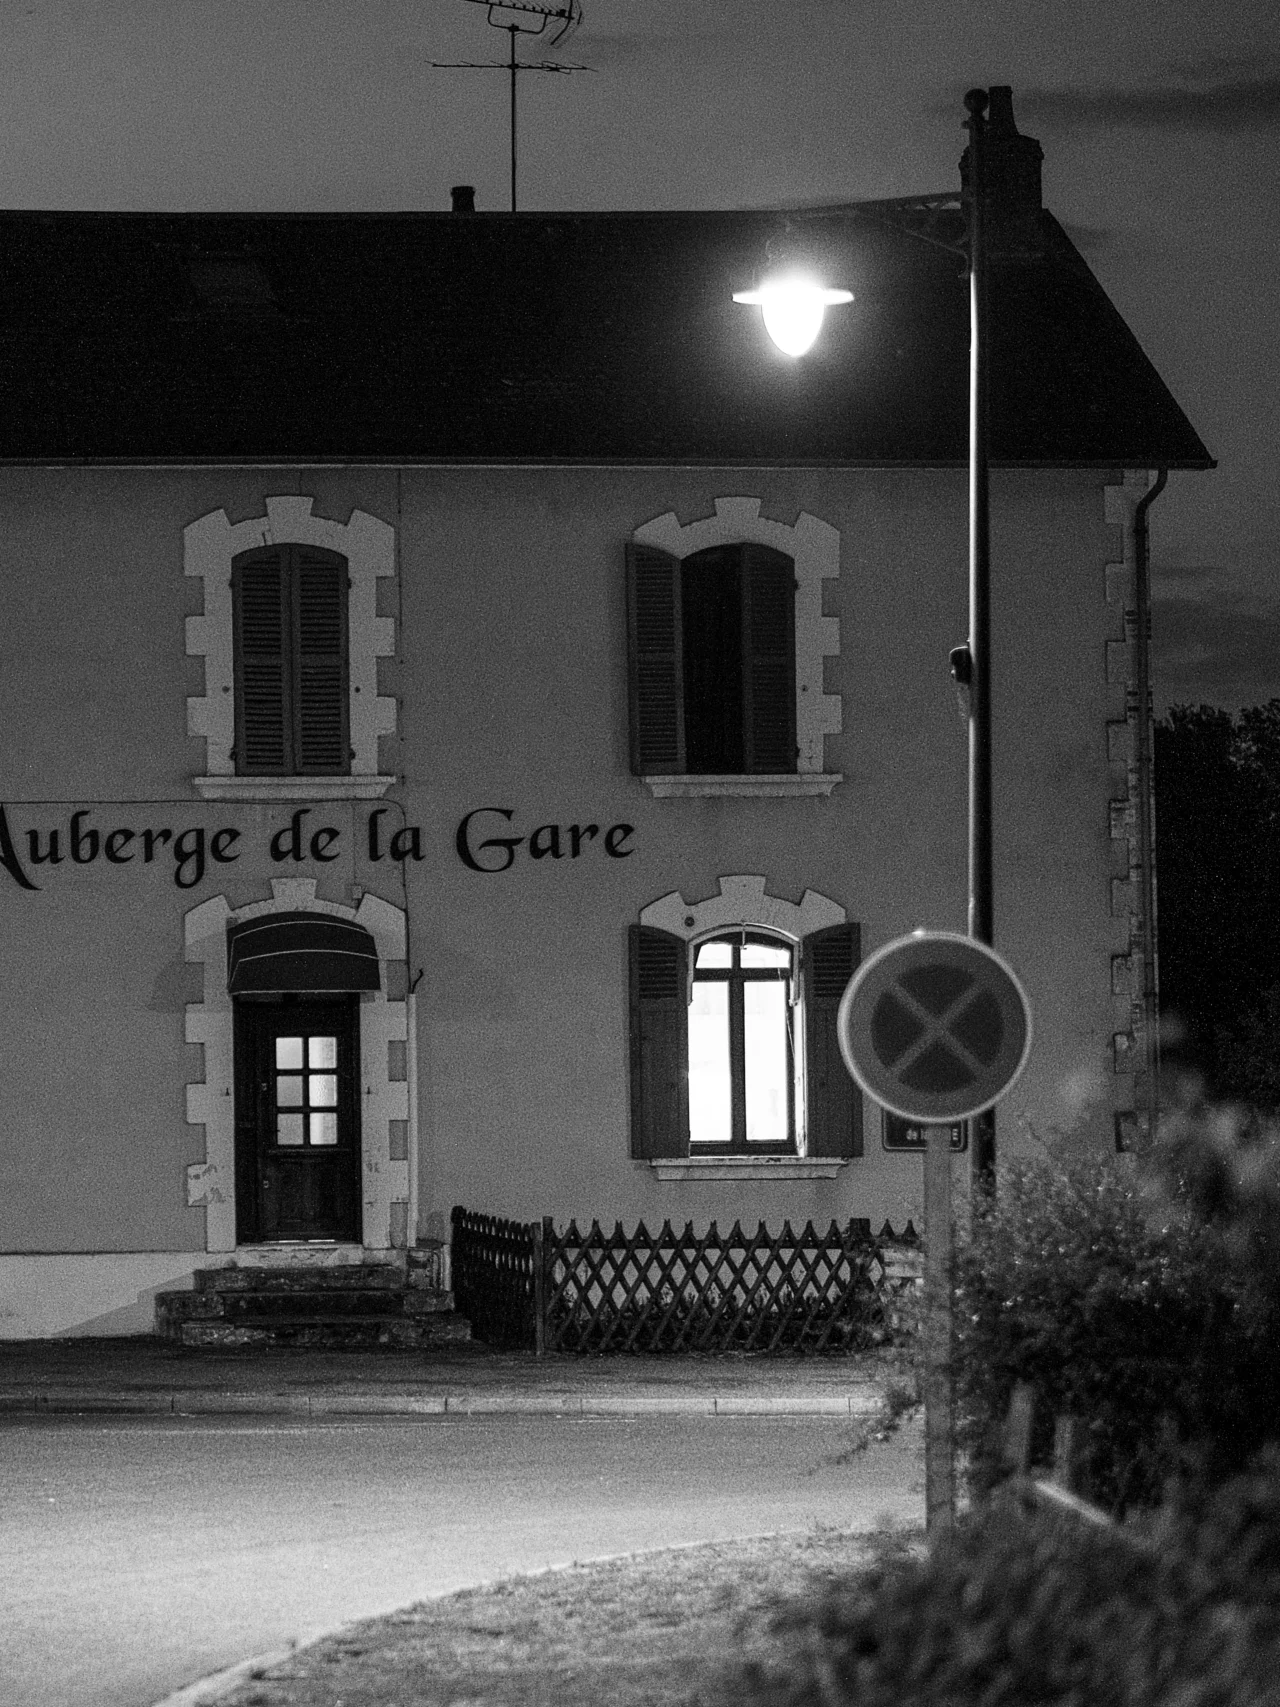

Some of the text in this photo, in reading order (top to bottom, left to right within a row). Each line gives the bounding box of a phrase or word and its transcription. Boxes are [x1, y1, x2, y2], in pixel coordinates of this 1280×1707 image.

[271, 809, 341, 863] de
[369, 809, 425, 863] la
[455, 807, 636, 873] Gare
